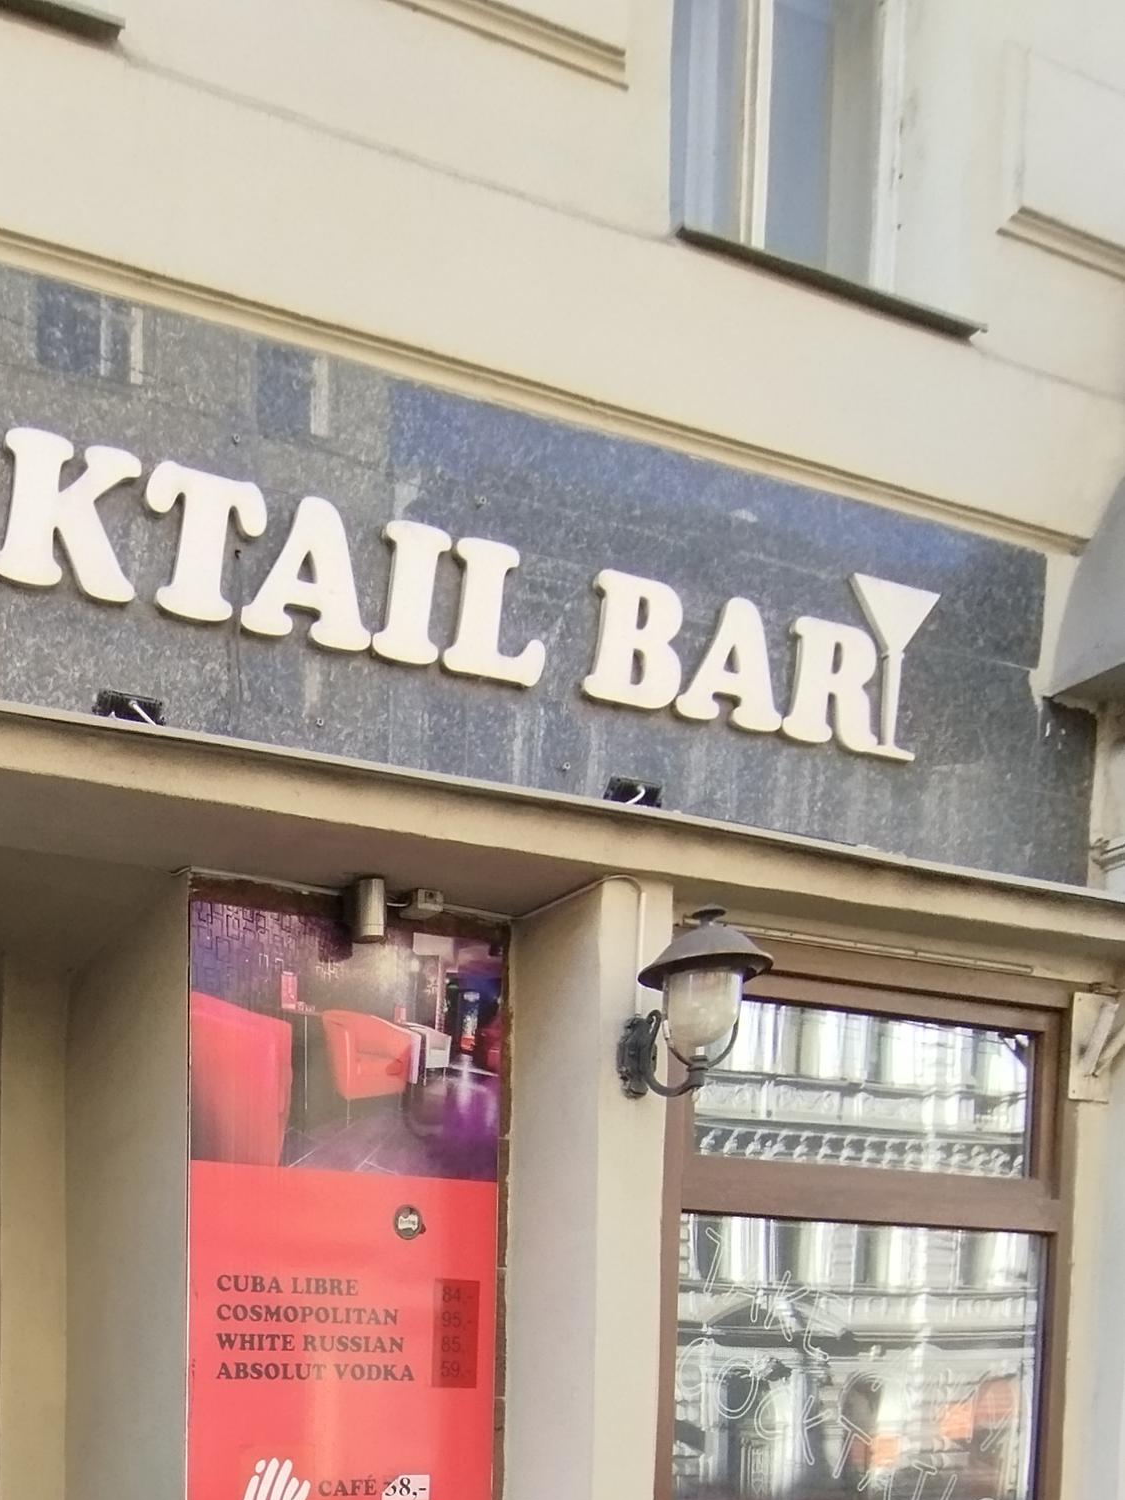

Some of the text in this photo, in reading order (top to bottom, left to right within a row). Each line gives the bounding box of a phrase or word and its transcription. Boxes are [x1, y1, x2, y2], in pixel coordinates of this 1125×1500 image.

[581, 568, 880, 757] BAR
[216, 1274, 359, 1296] CUBA LIBRE
[216, 1303, 399, 1326] COSMOPOLITAN
[216, 1332, 405, 1354] WHITE RUSSIAN
[216, 1362, 415, 1382] ABSOLUT VODKA
[318, 1474, 377, 1497] CAFÉ
